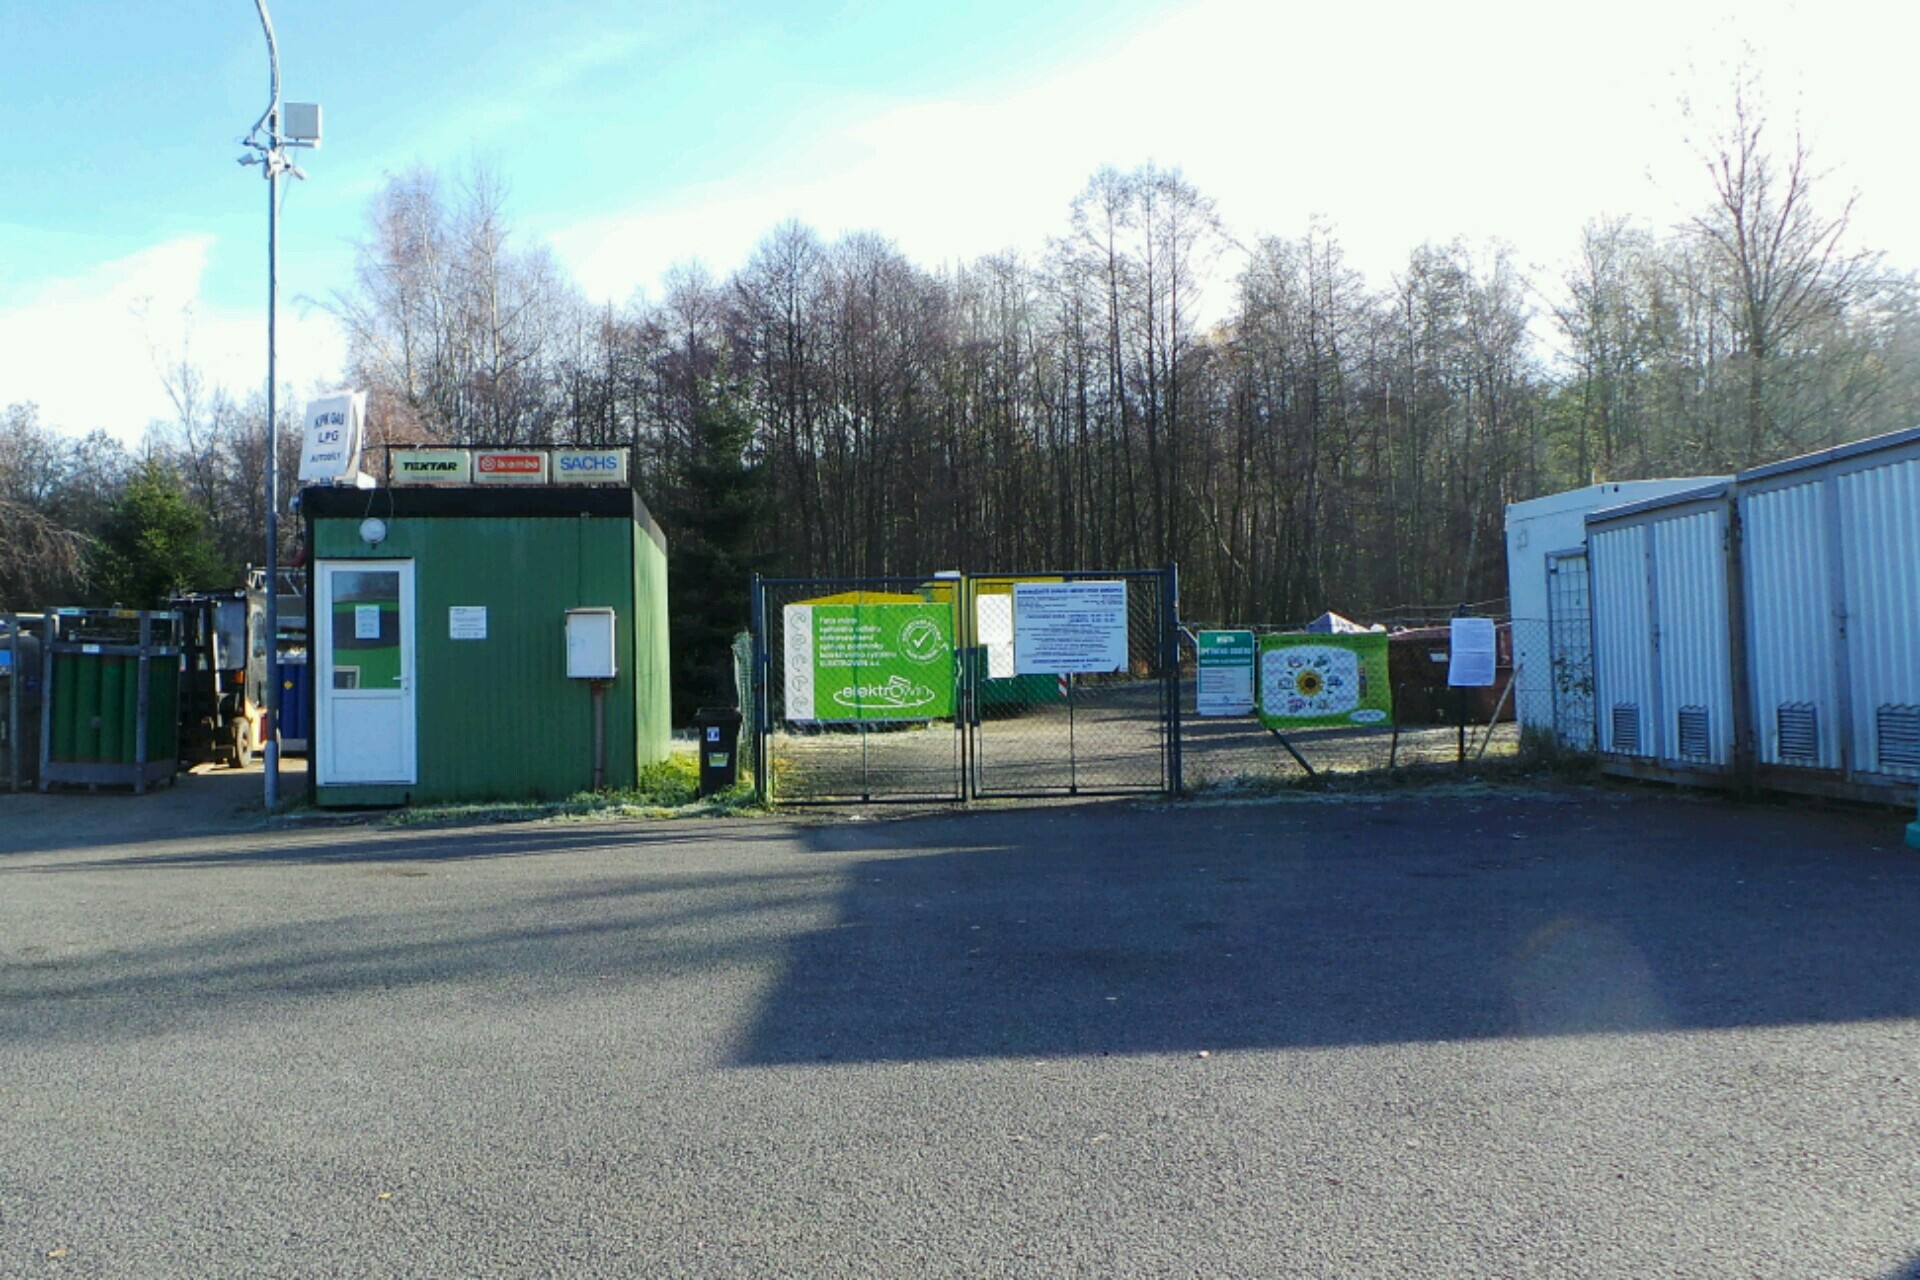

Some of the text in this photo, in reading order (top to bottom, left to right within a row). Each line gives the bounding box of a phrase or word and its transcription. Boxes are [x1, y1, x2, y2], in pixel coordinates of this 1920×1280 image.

[318, 430, 339, 443] LPG
[403, 461, 458, 471] TEXTAR
[497, 459, 538, 470] brembo
[560, 456, 617, 471] SACHS
